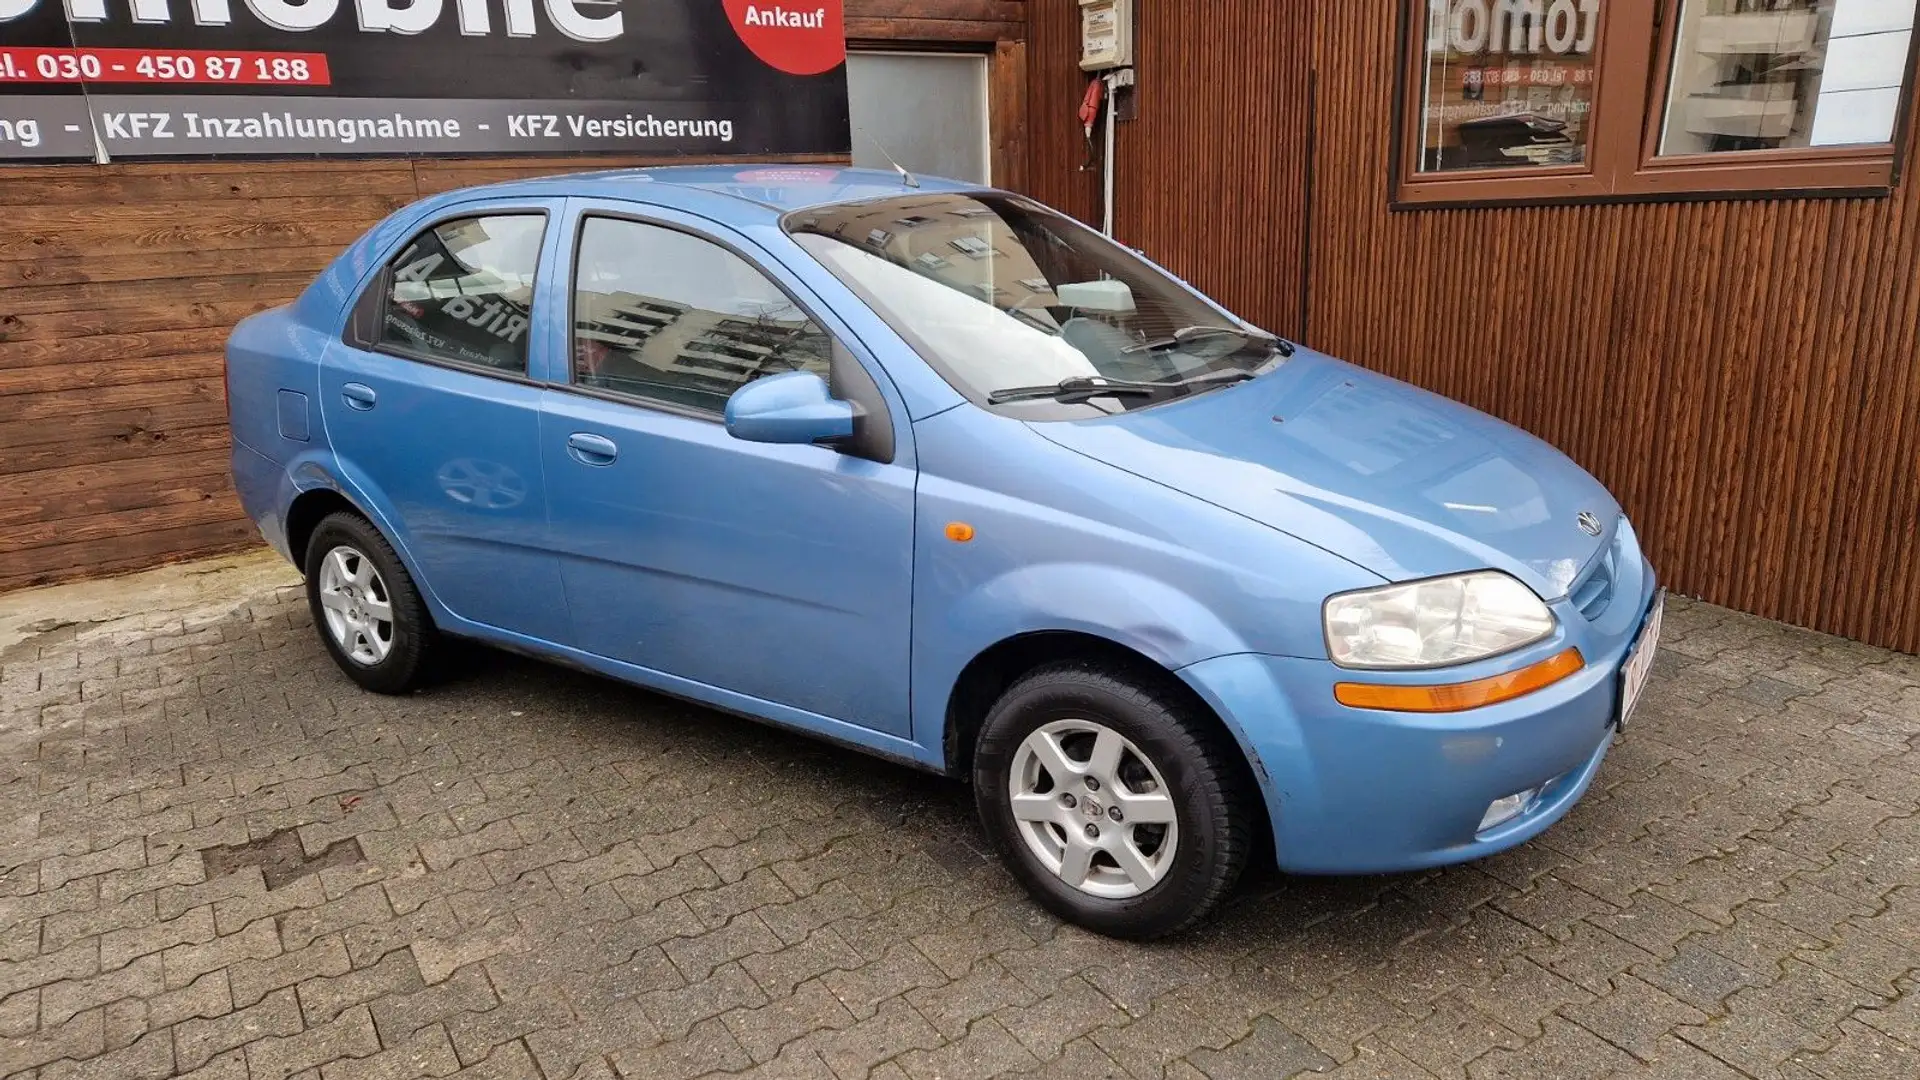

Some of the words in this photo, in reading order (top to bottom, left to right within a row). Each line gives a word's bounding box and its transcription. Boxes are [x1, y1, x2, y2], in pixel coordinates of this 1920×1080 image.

[745, 6, 825, 29] Ankauf
[0, 54, 27, 78] l.
[36, 54, 102, 79] 030
[111, 64, 126, 72] -
[136, 56, 196, 80] 450
[205, 57, 243, 80] 87
[256, 58, 310, 81] 188
[64, 124, 80, 132] -
[103, 112, 174, 139] KFZ
[183, 112, 461, 143] Inzahlungnahme
[478, 122, 491, 130] -
[507, 115, 561, 138] KFZ
[569, 114, 733, 142] Versicherung
